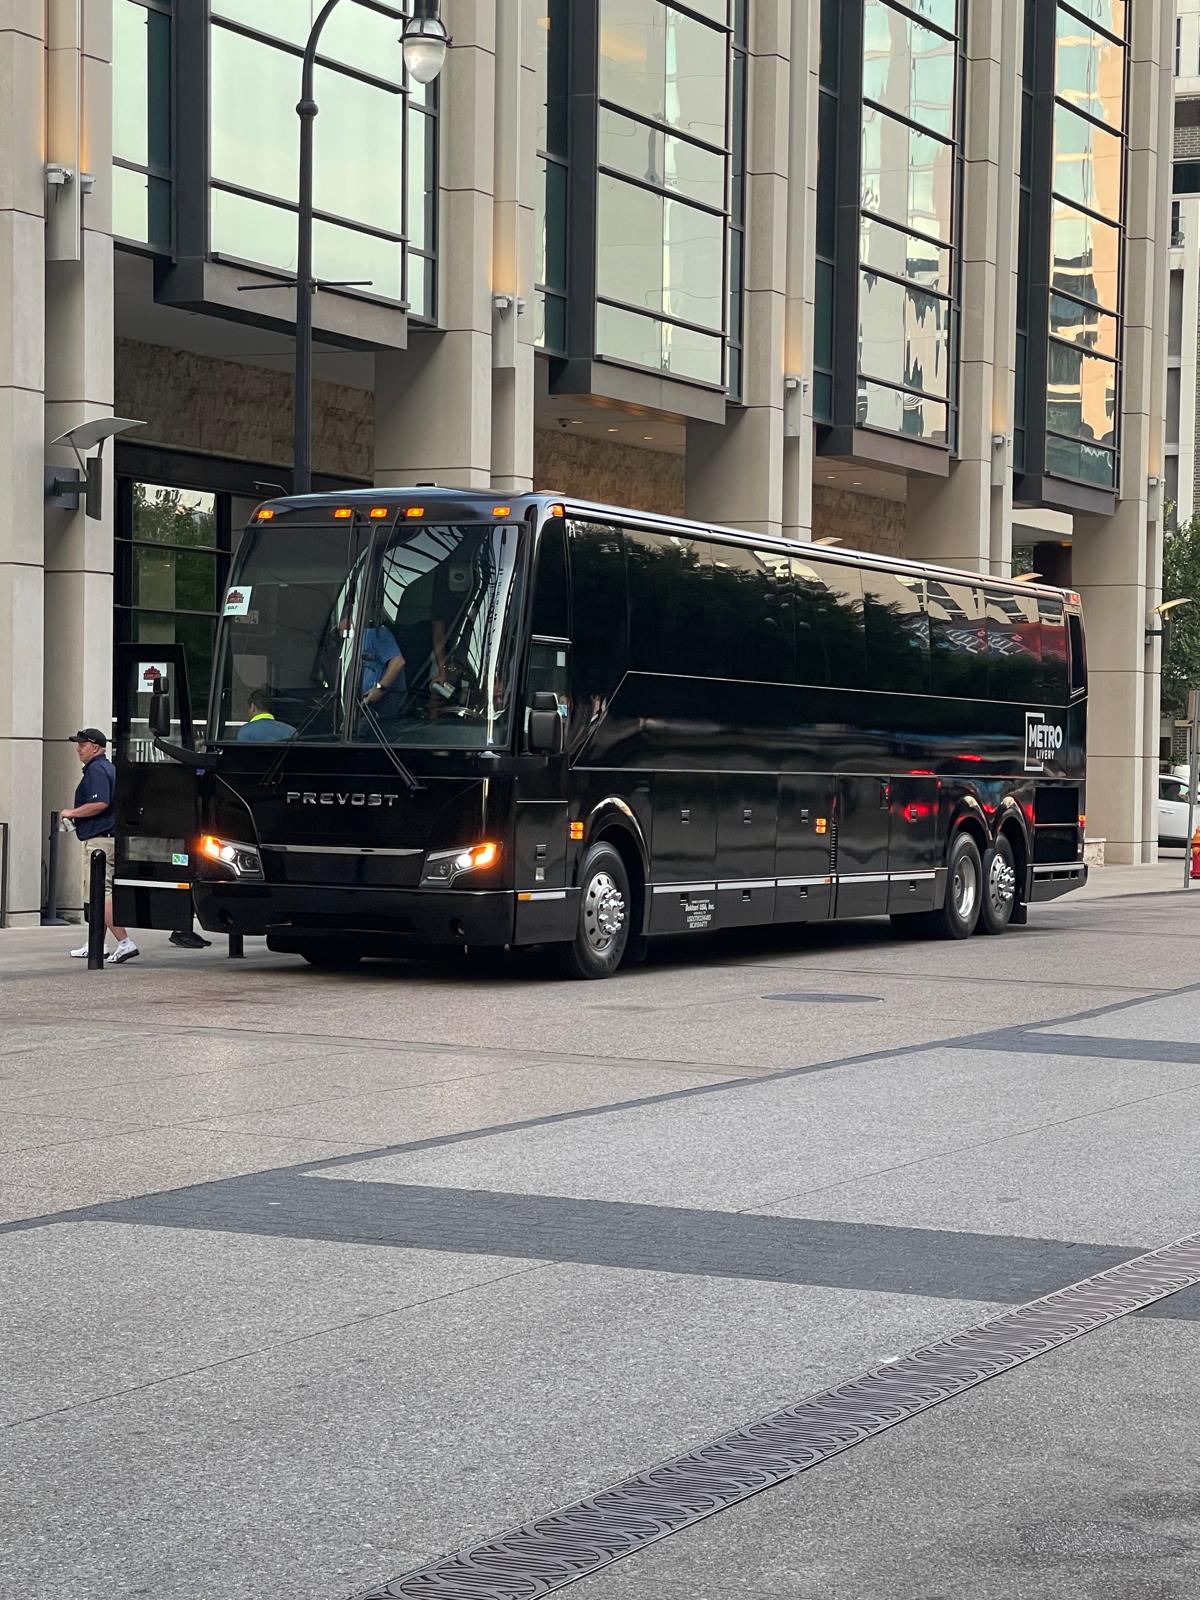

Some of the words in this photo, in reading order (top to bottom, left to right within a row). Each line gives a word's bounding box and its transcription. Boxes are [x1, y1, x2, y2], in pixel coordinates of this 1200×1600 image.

[1028, 724, 1063, 749] METRO
[1036, 749, 1055, 760] LIVERY
[286, 791, 399, 806] PREVOST
